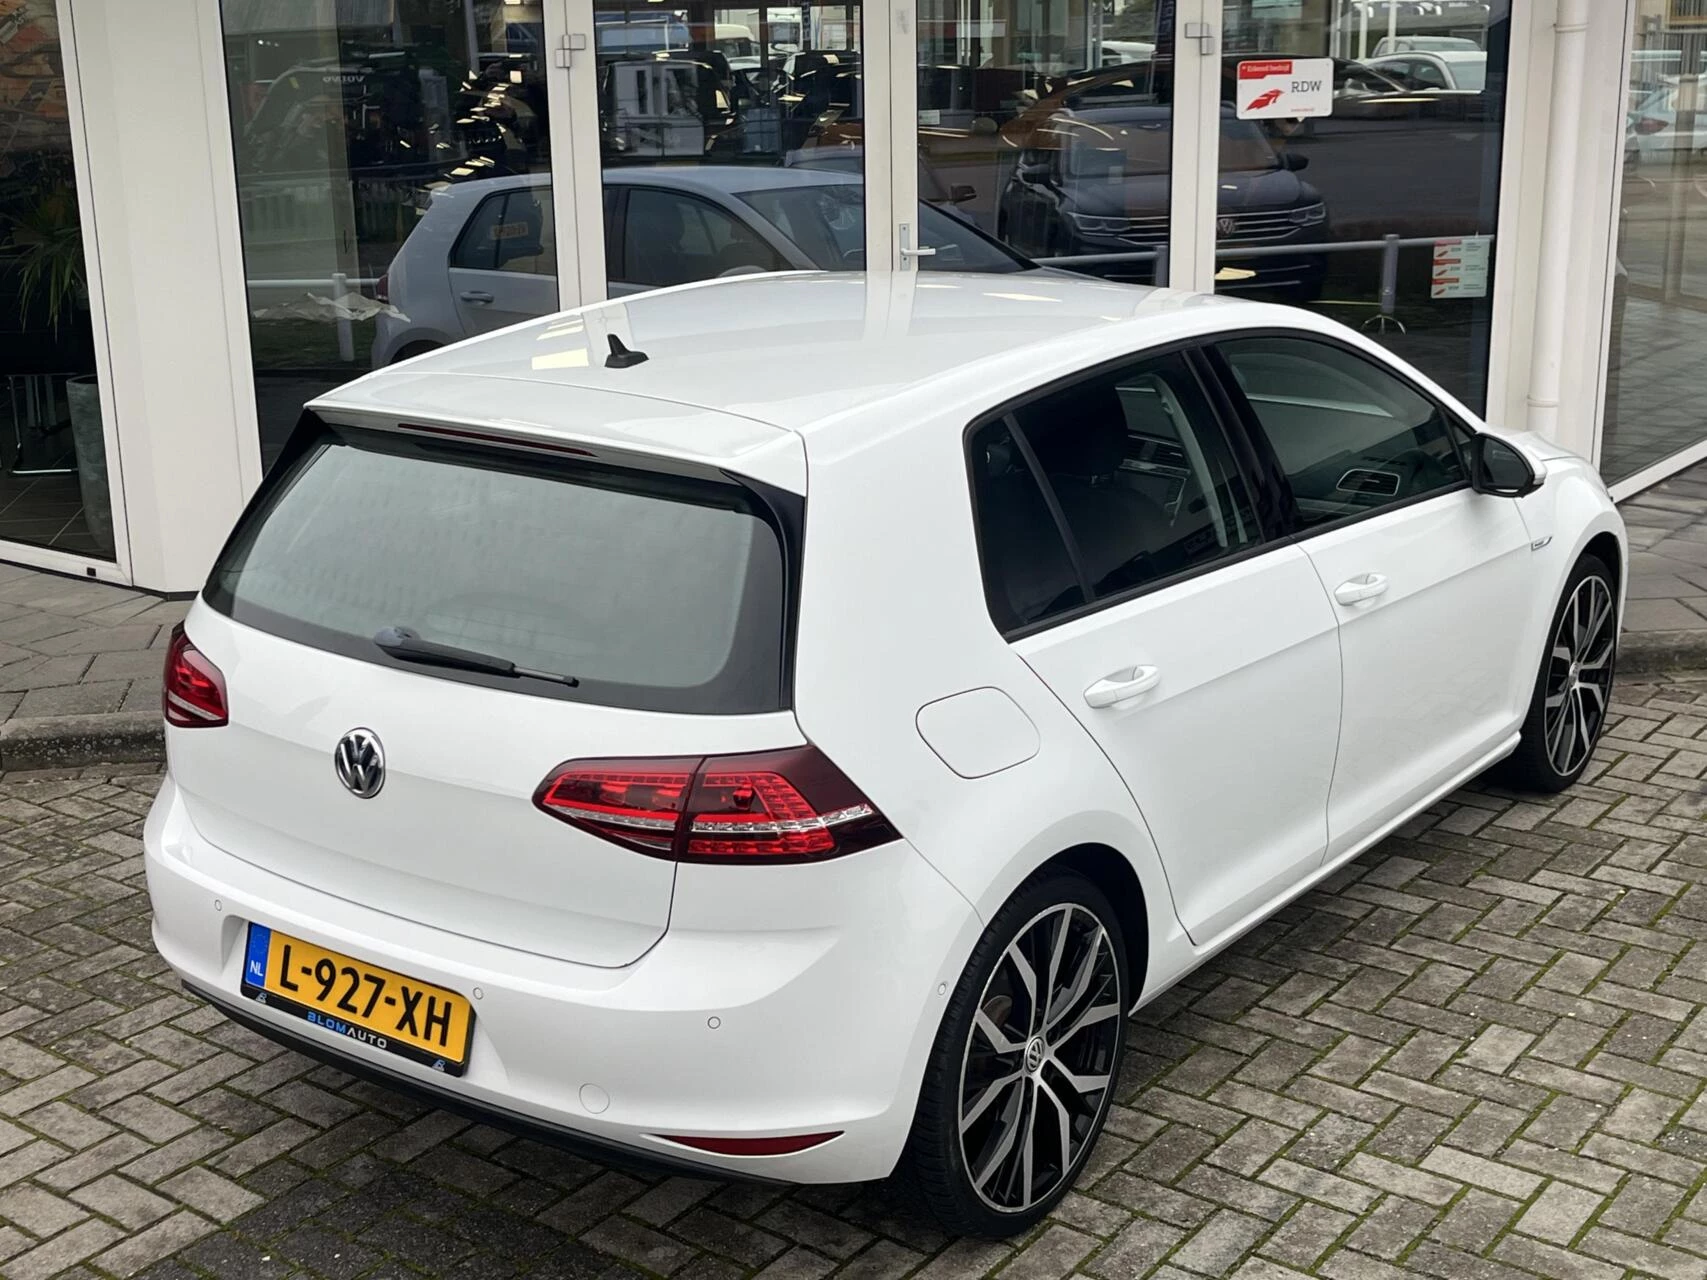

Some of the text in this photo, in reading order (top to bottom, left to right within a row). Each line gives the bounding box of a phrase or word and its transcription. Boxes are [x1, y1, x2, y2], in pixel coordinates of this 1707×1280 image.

[1291, 80, 1322, 94] RDW
[250, 960, 264, 977] NL
[279, 944, 453, 1047] L-927-XH
[306, 1011, 388, 1049] BLOMAUTO
